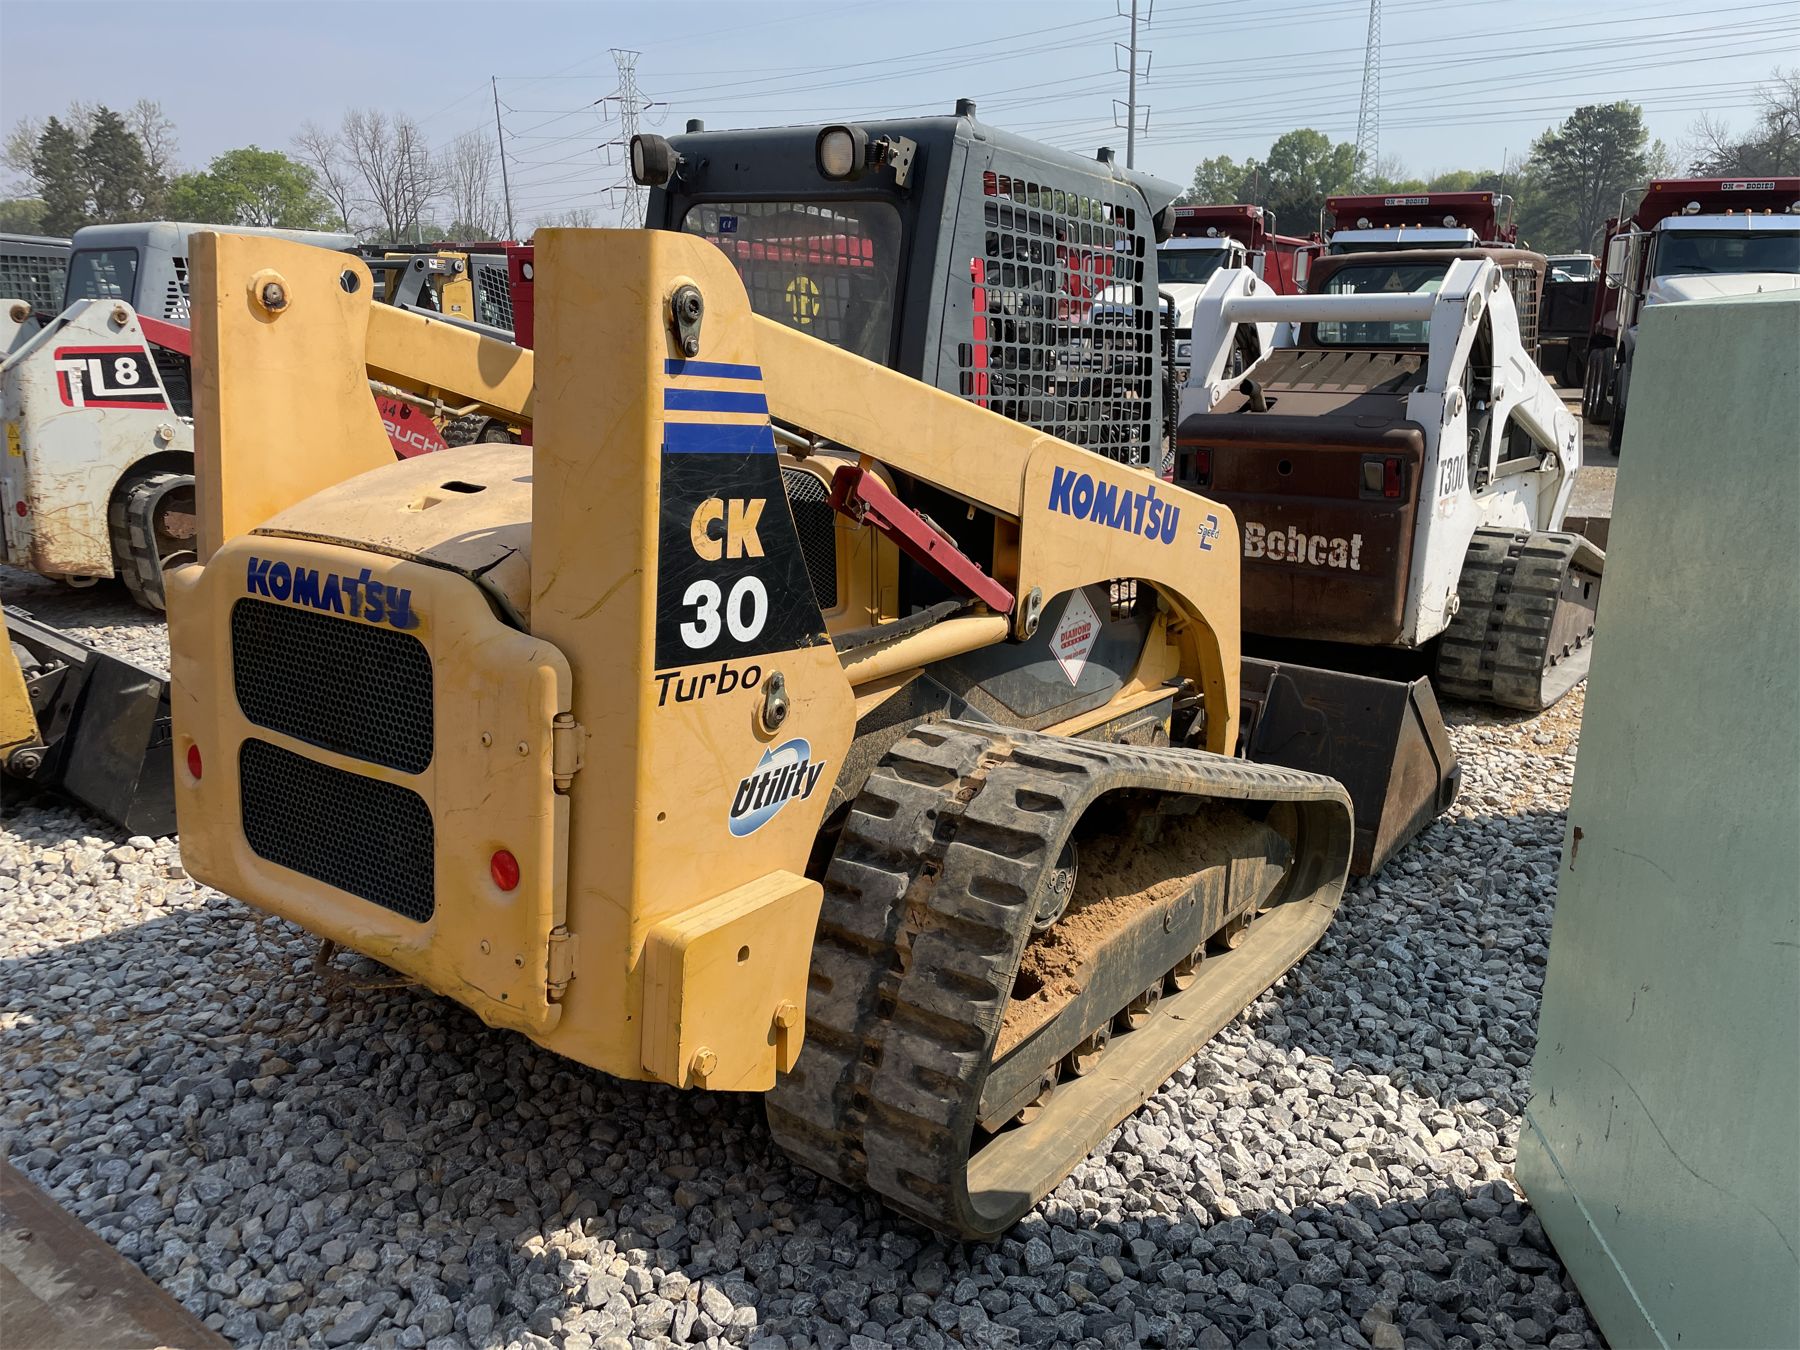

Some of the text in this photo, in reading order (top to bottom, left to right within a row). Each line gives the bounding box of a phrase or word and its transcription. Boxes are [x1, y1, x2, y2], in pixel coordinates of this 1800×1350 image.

[55, 357, 162, 408] TL8
[1439, 454, 1466, 497] T300
[690, 497, 767, 561] CK
[1048, 466, 1180, 545] KOMATSU
[1197, 523, 1220, 540] Speed
[1244, 521, 1363, 571] Bobcat
[247, 556, 413, 629] KOMATSU
[680, 575, 769, 649] 30
[1060, 622, 1092, 642] DIAMOND
[654, 663, 762, 707] Turbo
[731, 760, 826, 818] Utility
